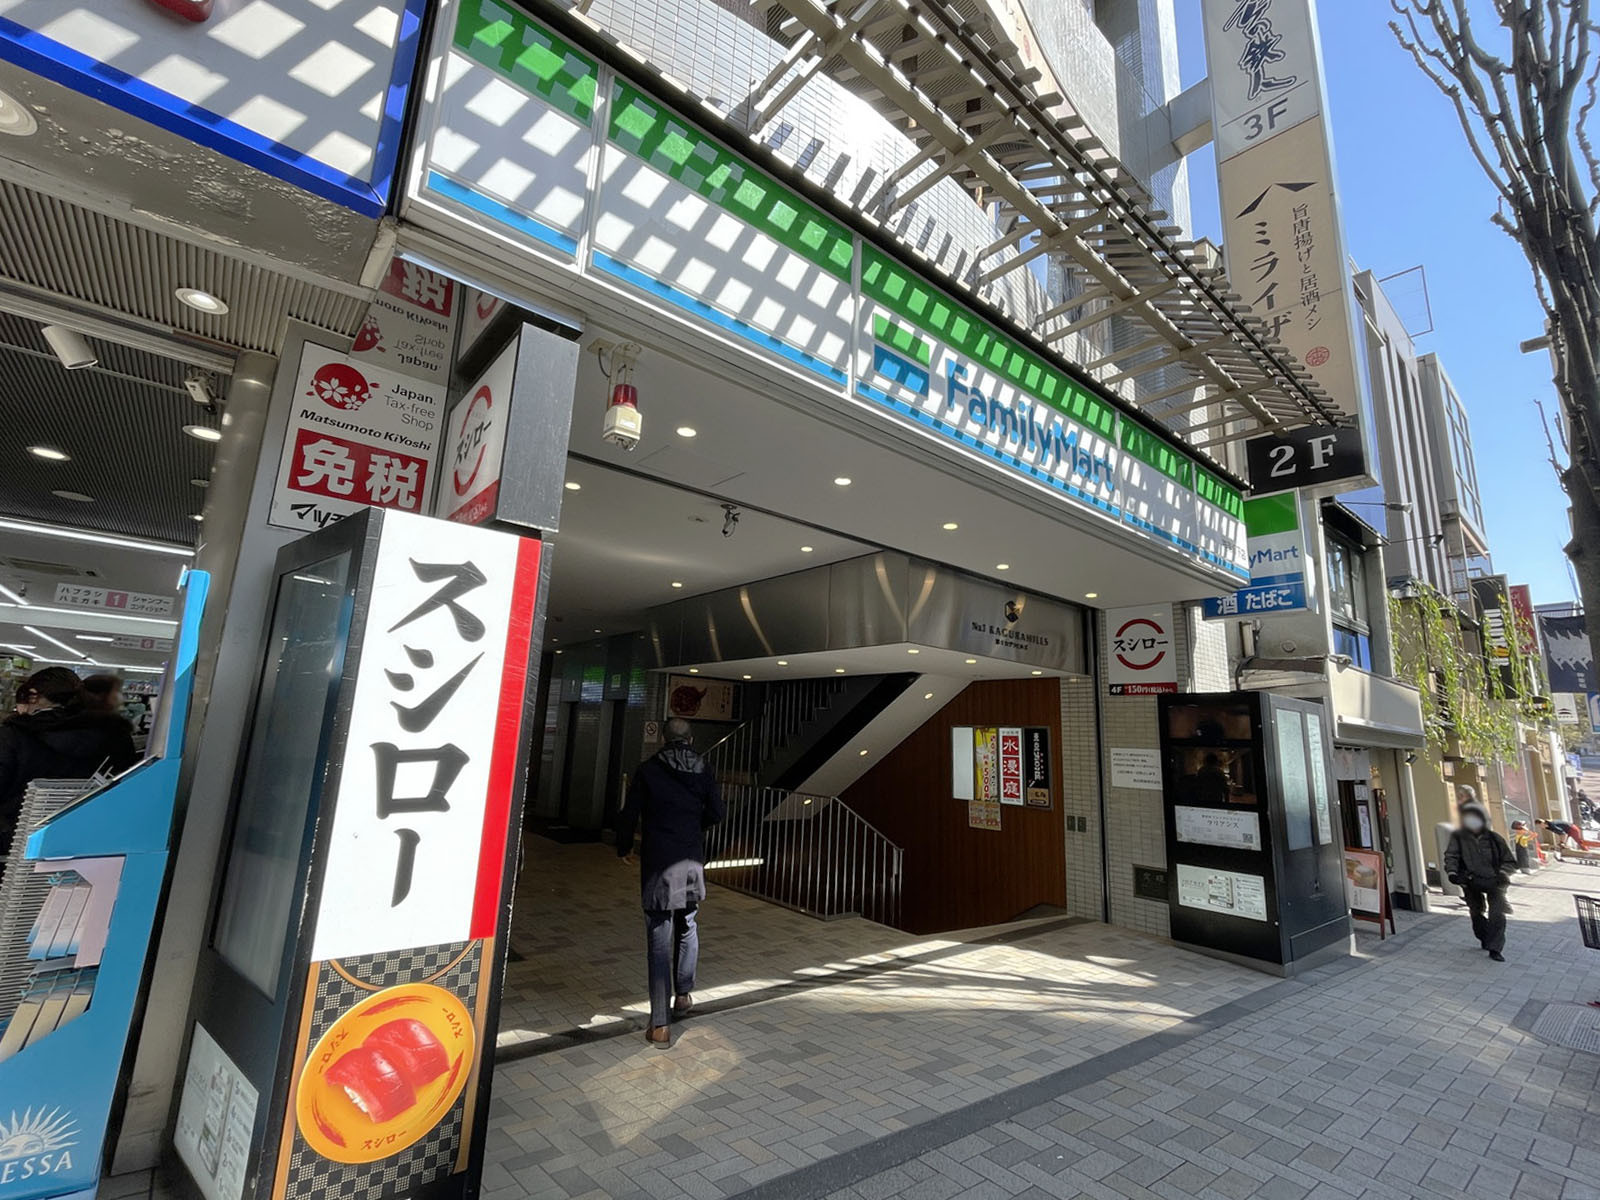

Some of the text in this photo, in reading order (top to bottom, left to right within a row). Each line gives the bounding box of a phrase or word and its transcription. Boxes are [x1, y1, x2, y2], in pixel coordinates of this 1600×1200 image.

[1243, 97, 1289, 142] 3F
[384, 395, 436, 419] Tax-free
[299, 409, 382, 439] Matsumoto
[401, 413, 434, 431] Shop
[946, 358, 1115, 492] FamilyMart
[1268, 434, 1338, 477] 2F
[296, 438, 420, 509] 免税
[1217, 589, 1293, 615] 酒 たばこ
[1113, 638, 1169, 653] スシロー
[1111, 686, 1122, 694] 4F
[387, 556, 488, 908] スシロー
[361, 1129, 407, 1151] スシロー
